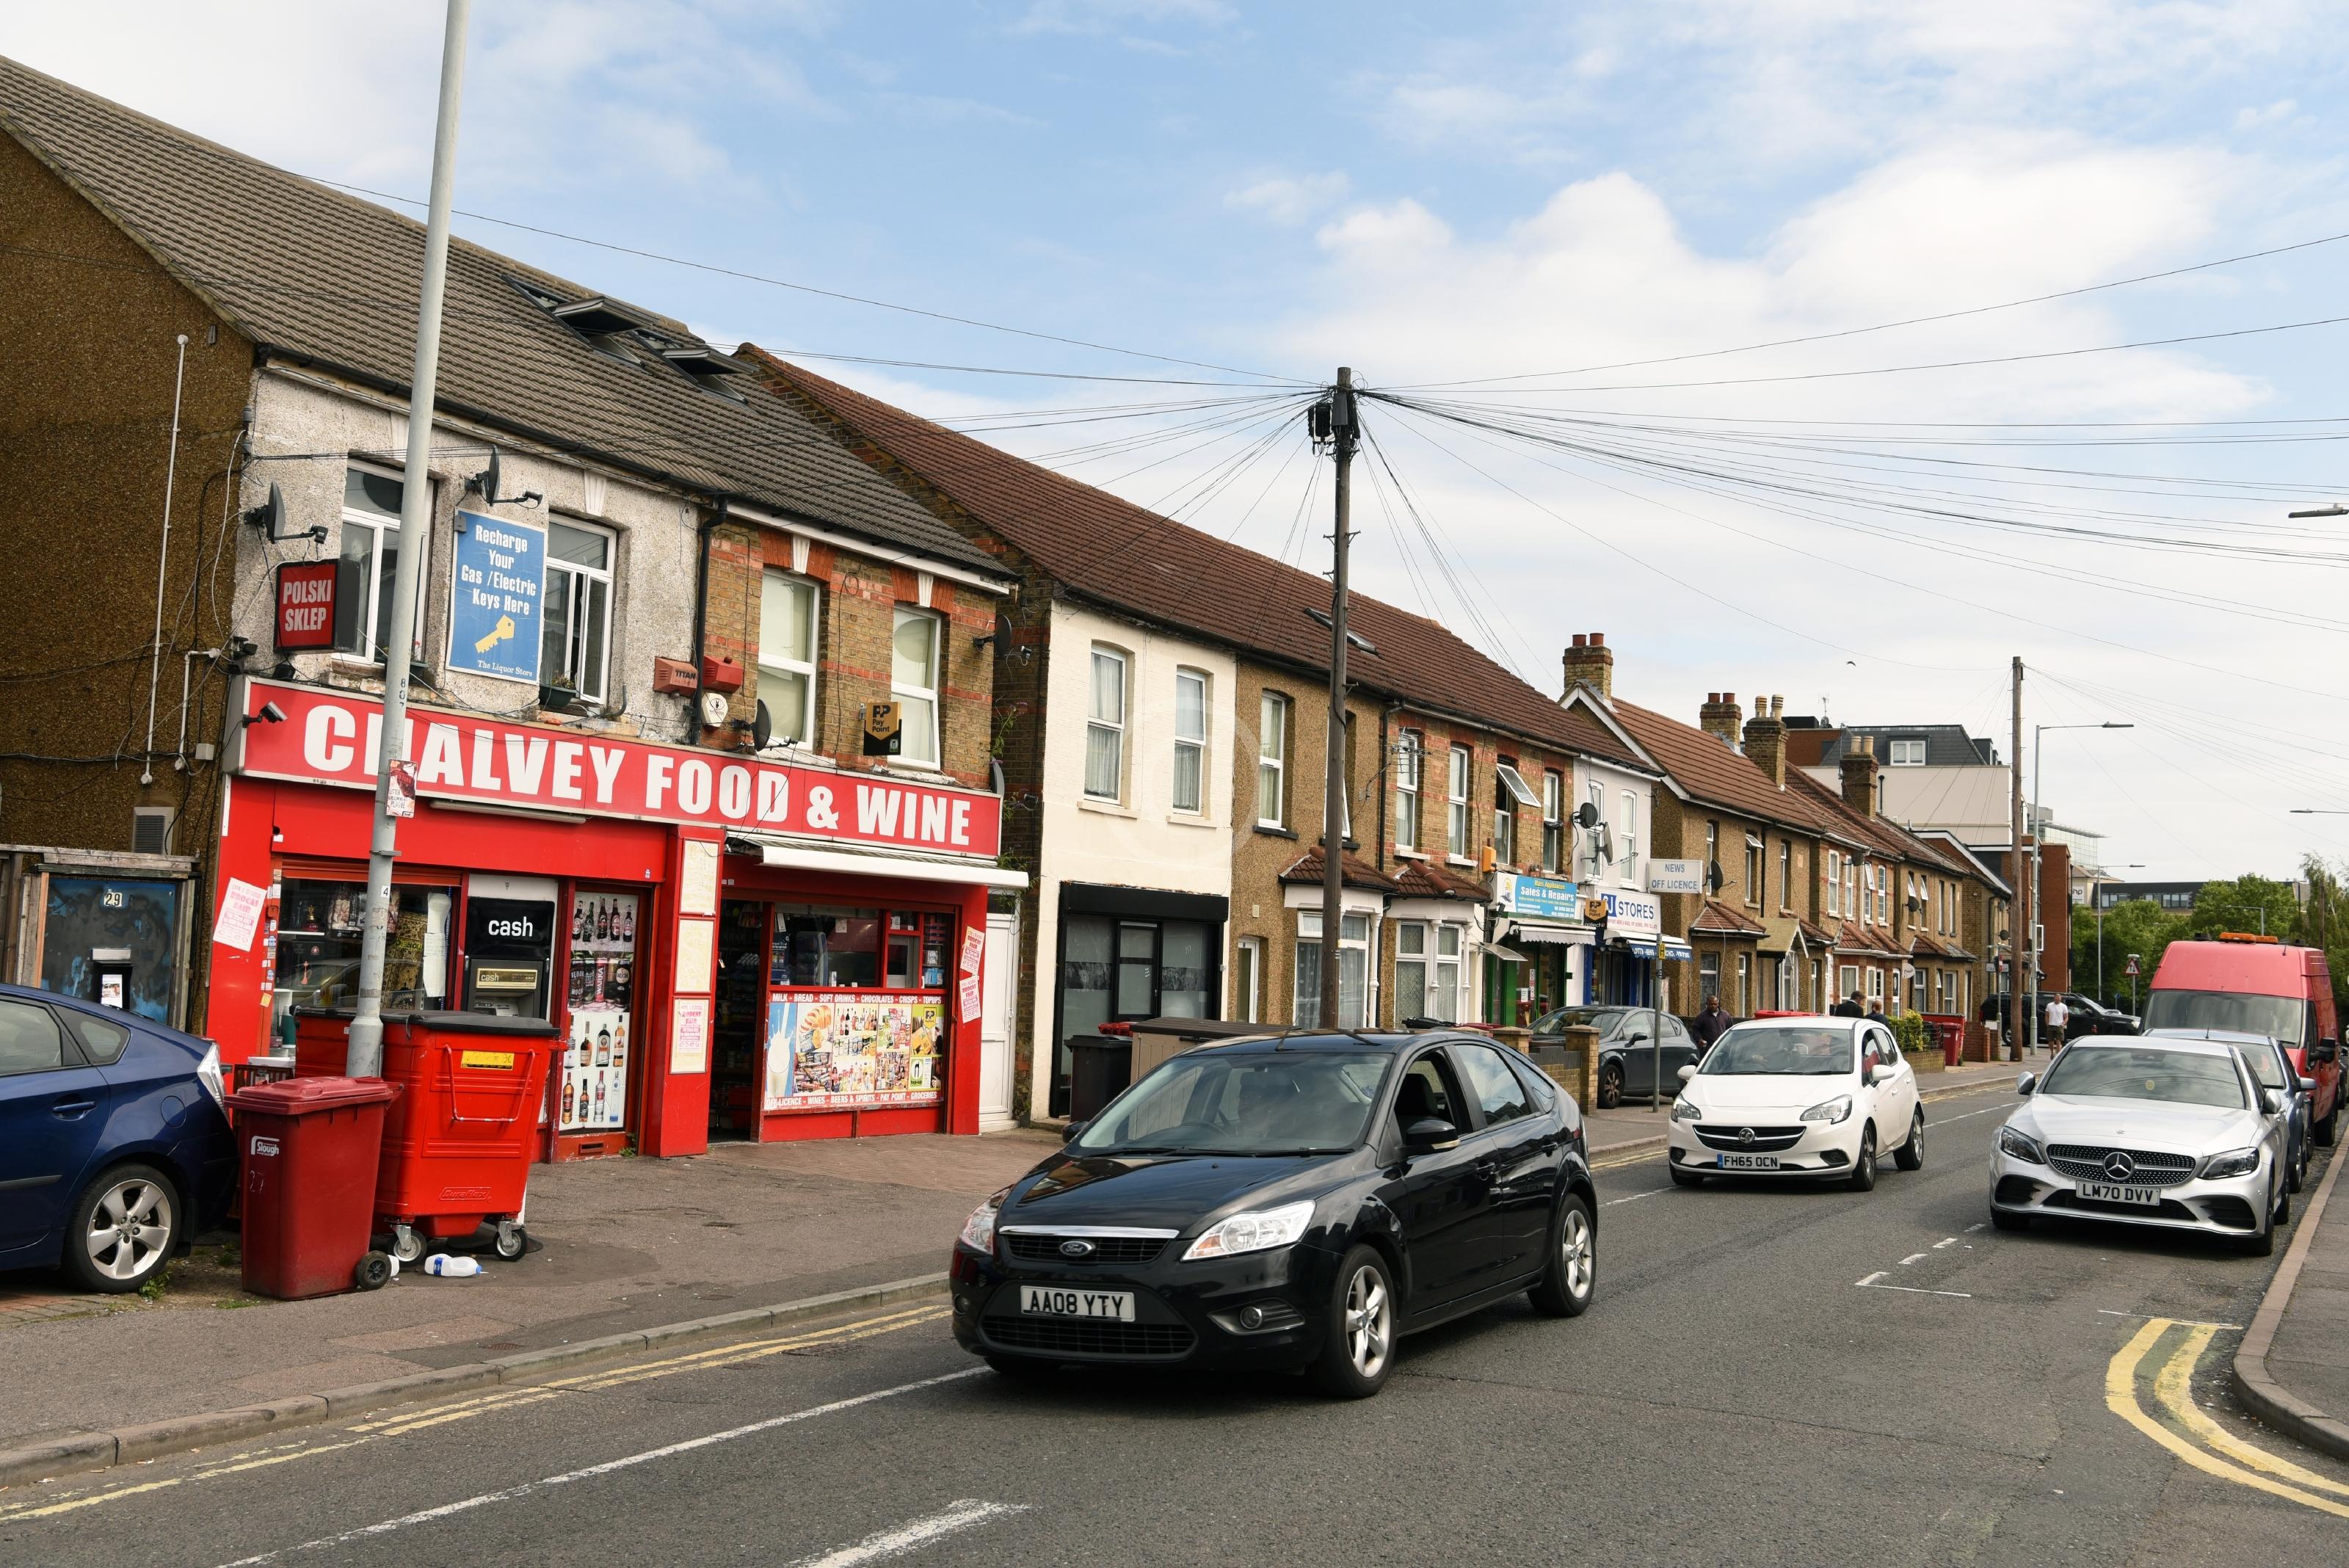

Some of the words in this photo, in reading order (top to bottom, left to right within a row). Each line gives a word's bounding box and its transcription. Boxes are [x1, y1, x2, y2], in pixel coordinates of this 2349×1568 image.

[476, 525, 528, 553] Recharge
[489, 549, 514, 570] Your
[461, 565, 482, 584] Gas
[283, 579, 332, 605] POLSKI
[472, 588, 500, 609] Keys
[504, 595, 529, 615] Here
[285, 607, 327, 631] SKLEP
[478, 660, 491, 669] The
[492, 662, 515, 674] Liquor
[515, 667, 533, 677] Store
[675, 669, 697, 680] TITAN
[304, 705, 626, 804] CHALVEY
[645, 754, 789, 823] FOOD
[807, 785, 839, 830] &
[857, 784, 970, 846] WINE
[1664, 863, 1685, 873] NEWS
[382, 887, 388, 896] 4
[1652, 879, 1665, 888] OFF
[1667, 881, 1697, 890] LICENCE
[105, 893, 120, 906] 29
[1520, 886, 1540, 899] Sales
[1542, 889, 1547, 898] &
[1548, 890, 1574, 901] Repairs
[1618, 901, 1655, 919] STORES
[488, 916, 533, 937] cash
[481, 973, 499, 981] cash
[596, 967, 604, 995] WARKA
[772, 993, 788, 1002] MILK
[794, 993, 814, 1002] BREAD
[819, 994, 833, 1002] SOFT
[835, 994, 855, 1003] DRINKS
[861, 995, 894, 1003] CHOCOLATES
[899, 995, 918, 1003] CRISPS
[923, 996, 942, 1004] TOPUPS
[807, 1096, 826, 1105] WINES
[831, 1095, 849, 1104] BEERS
[850, 1095, 854, 1103] &
[856, 1094, 875, 1103] SPIRITS
[881, 1093, 890, 1101] PAY
[891, 1092, 907, 1100] POINT
[911, 1091, 937, 1100] GROCERIES
[257, 1141, 279, 1157] Slough
[1724, 1155, 1752, 1166] FH65
[1755, 1156, 1777, 1167] OCN
[2083, 1183, 2120, 1199] LM70
[2124, 1188, 2153, 1202] DVV
[1065, 1244, 1084, 1253] Ford
[1030, 1290, 1078, 1314] AA08
[1083, 1293, 1124, 1317] YTY
